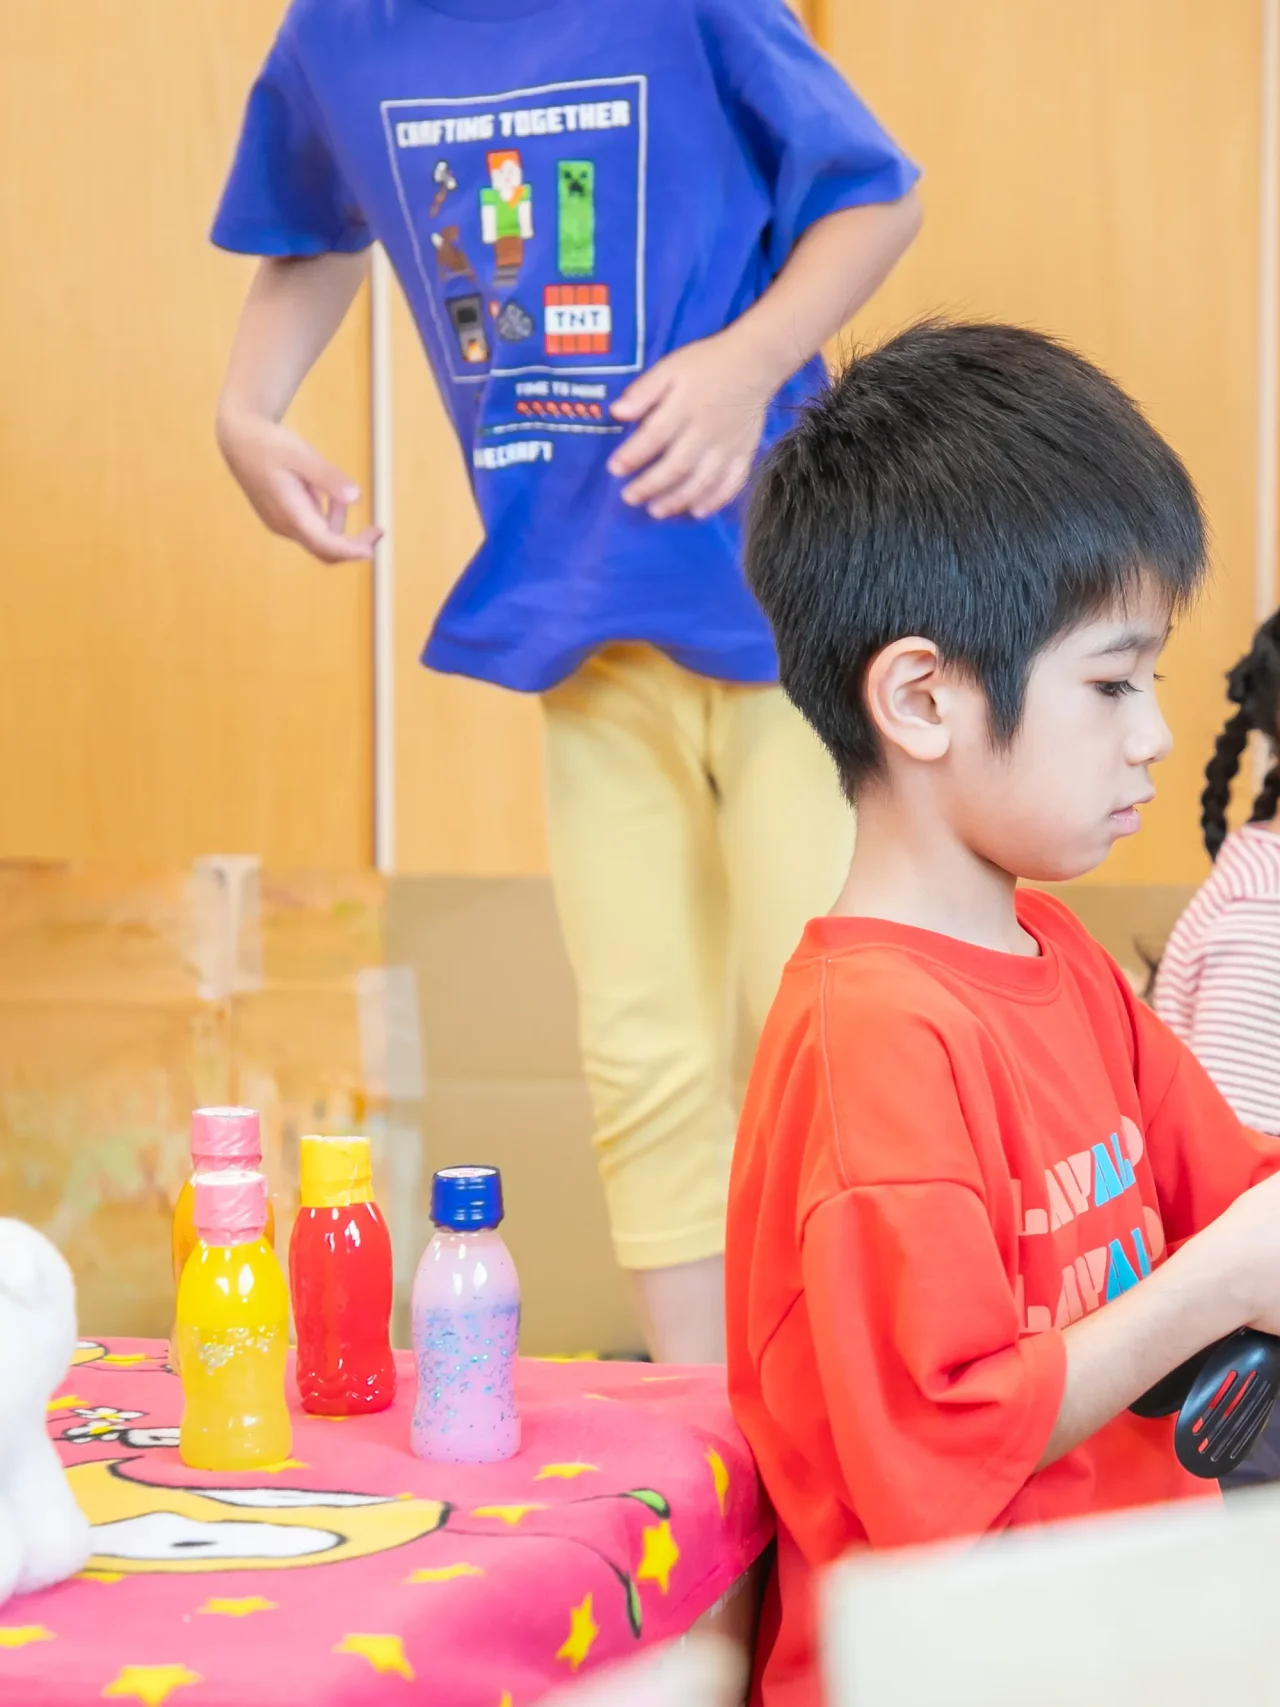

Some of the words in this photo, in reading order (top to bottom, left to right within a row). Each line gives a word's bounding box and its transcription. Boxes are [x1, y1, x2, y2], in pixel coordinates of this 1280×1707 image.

[396, 114, 494, 147] CRAFTING
[498, 100, 631, 137] TOGETHER
[554, 311, 600, 327] TNT
